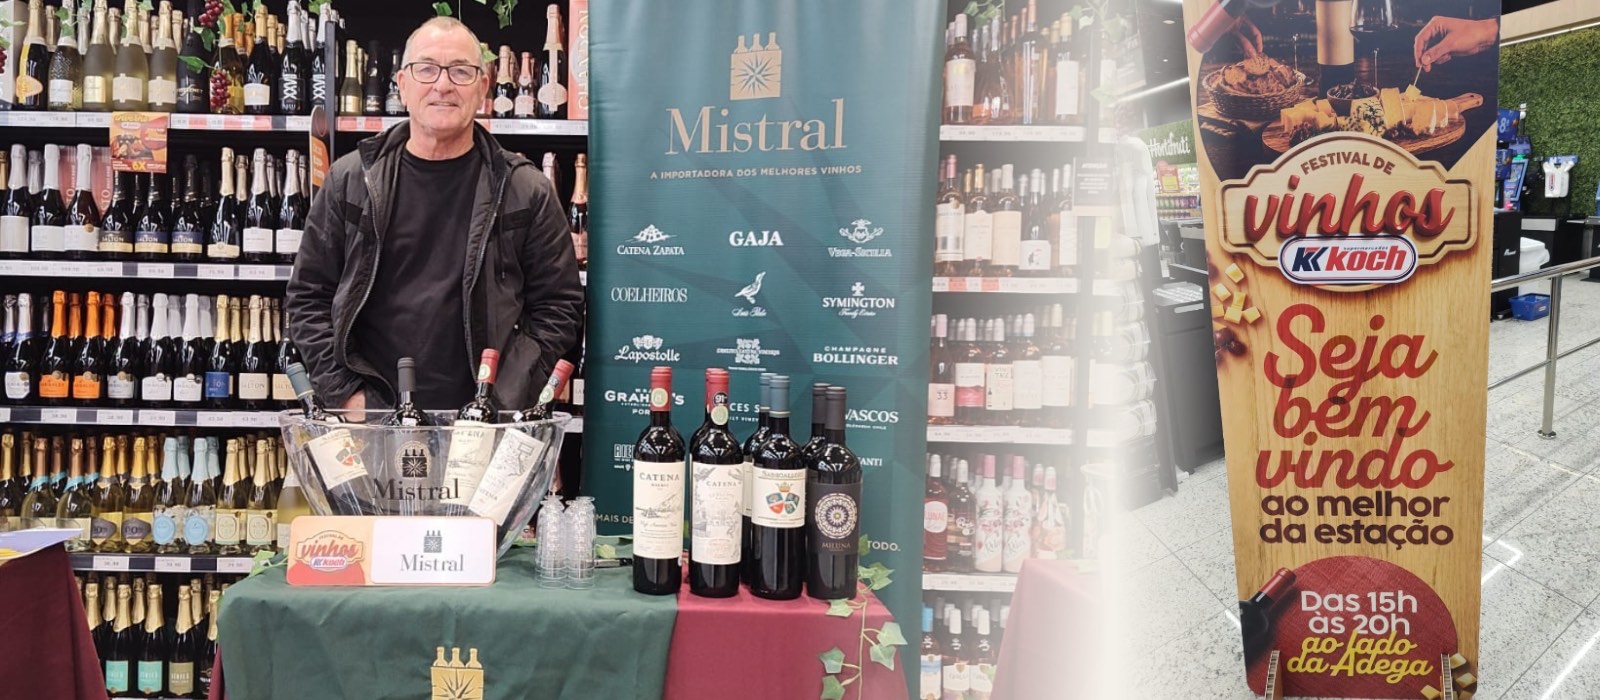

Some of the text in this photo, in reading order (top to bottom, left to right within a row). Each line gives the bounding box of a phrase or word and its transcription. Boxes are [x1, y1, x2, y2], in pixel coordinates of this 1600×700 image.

[664, 97, 847, 155] Mistral
[661, 169, 733, 179] IMPORTADORA
[737, 168, 758, 177] DOS
[761, 166, 818, 176] MELHORES
[821, 165, 862, 174] VINHOS
[1300, 152, 1396, 176] FESTIVAL DE
[1244, 173, 1456, 242] vinhos
[729, 230, 784, 246] GAJA
[617, 245, 685, 256] CATENA ZAPATA
[1325, 245, 1407, 272] koch
[611, 287, 688, 303] COELHEIROS
[822, 297, 896, 309] SYMINGTON
[614, 345, 681, 364] Lapostolle
[813, 353, 899, 366] BOLLINGER
[824, 346, 887, 354] CHAMPAGNE
[1264, 303, 1439, 404] Seja
[604, 390, 685, 406] GRAH'S
[1273, 373, 1432, 438] bem
[1255, 427, 1456, 489] vindo
[639, 472, 681, 482] CATENA
[373, 477, 461, 501] Mistral
[1260, 490, 1450, 517] ao melhor
[595, 513, 620, 523] MAIS
[1259, 518, 1454, 550] da estação
[300, 536, 358, 559] vinhos
[867, 540, 901, 552] TODO.
[400, 554, 465, 572] Mistral
[1301, 590, 1418, 614] Das 15h
[1308, 611, 1410, 636] às 20h
[1301, 629, 1418, 656] ao lado
[1286, 648, 1434, 684] da Adega
